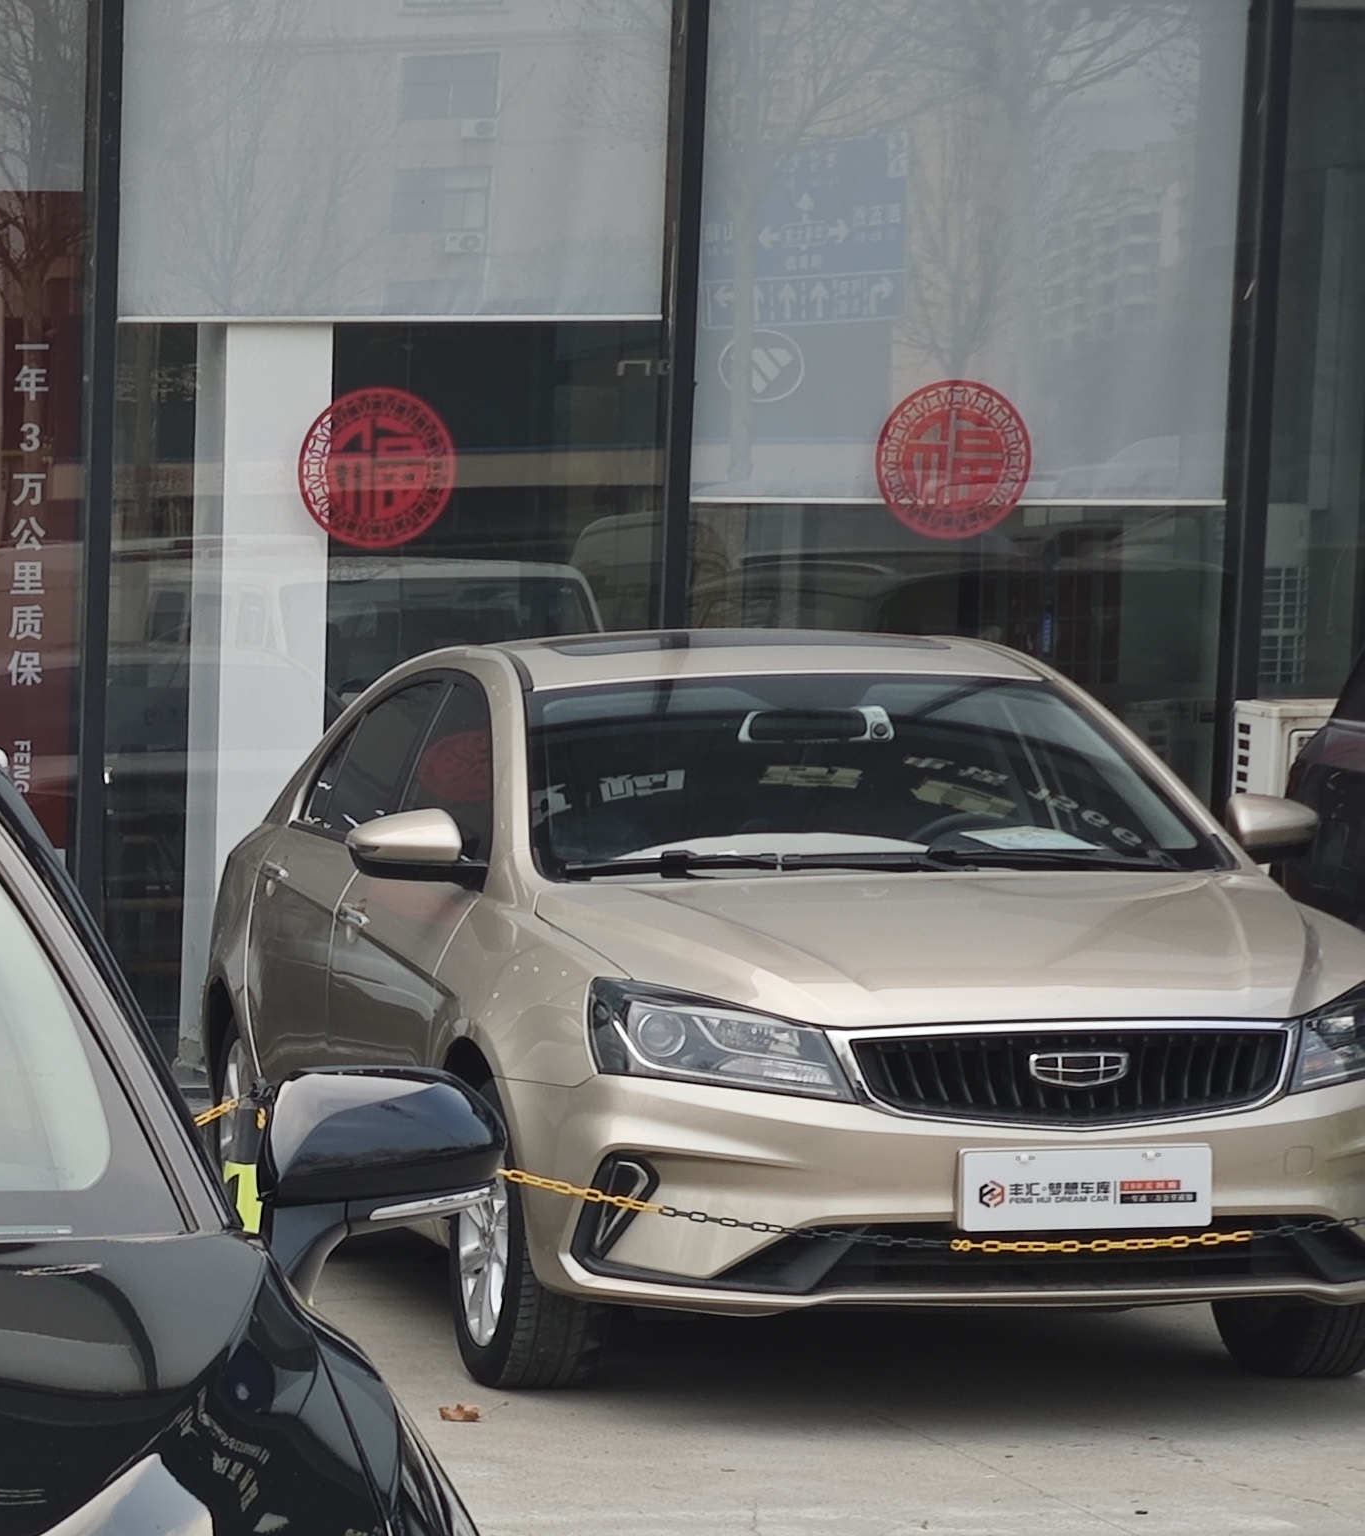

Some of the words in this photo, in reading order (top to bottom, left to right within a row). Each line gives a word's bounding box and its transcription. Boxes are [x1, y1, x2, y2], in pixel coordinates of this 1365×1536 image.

[7, 343, 50, 687] 一年3万公里质保
